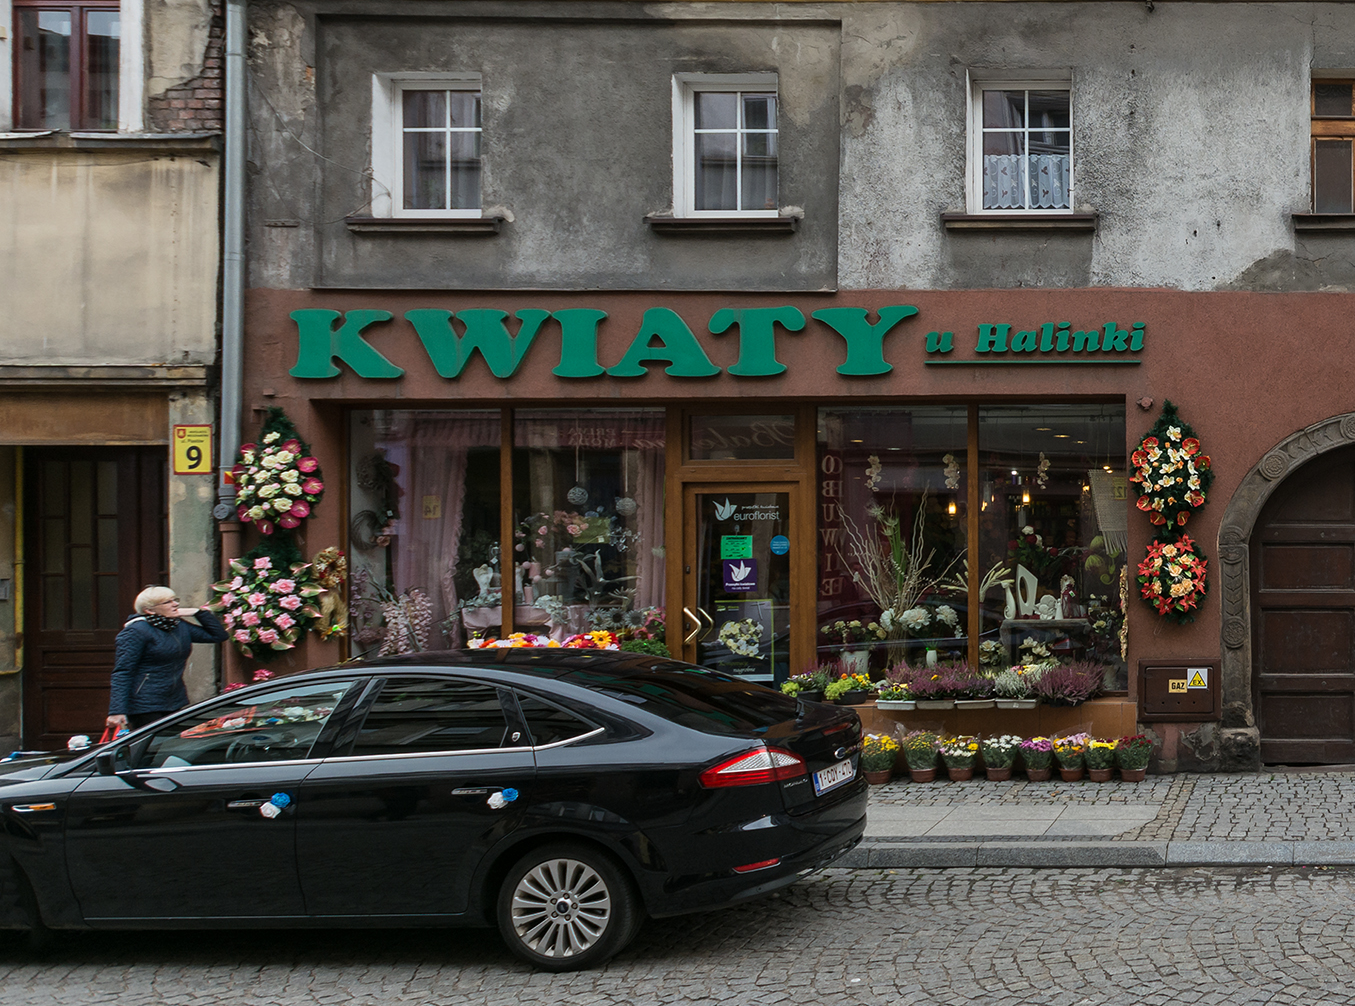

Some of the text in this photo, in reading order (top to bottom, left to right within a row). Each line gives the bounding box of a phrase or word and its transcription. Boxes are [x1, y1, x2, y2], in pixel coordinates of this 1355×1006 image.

[288, 305, 1146, 379] KWIATY u Halinki
[186, 445, 203, 470] 9
[733, 510, 779, 521] euroflorist
